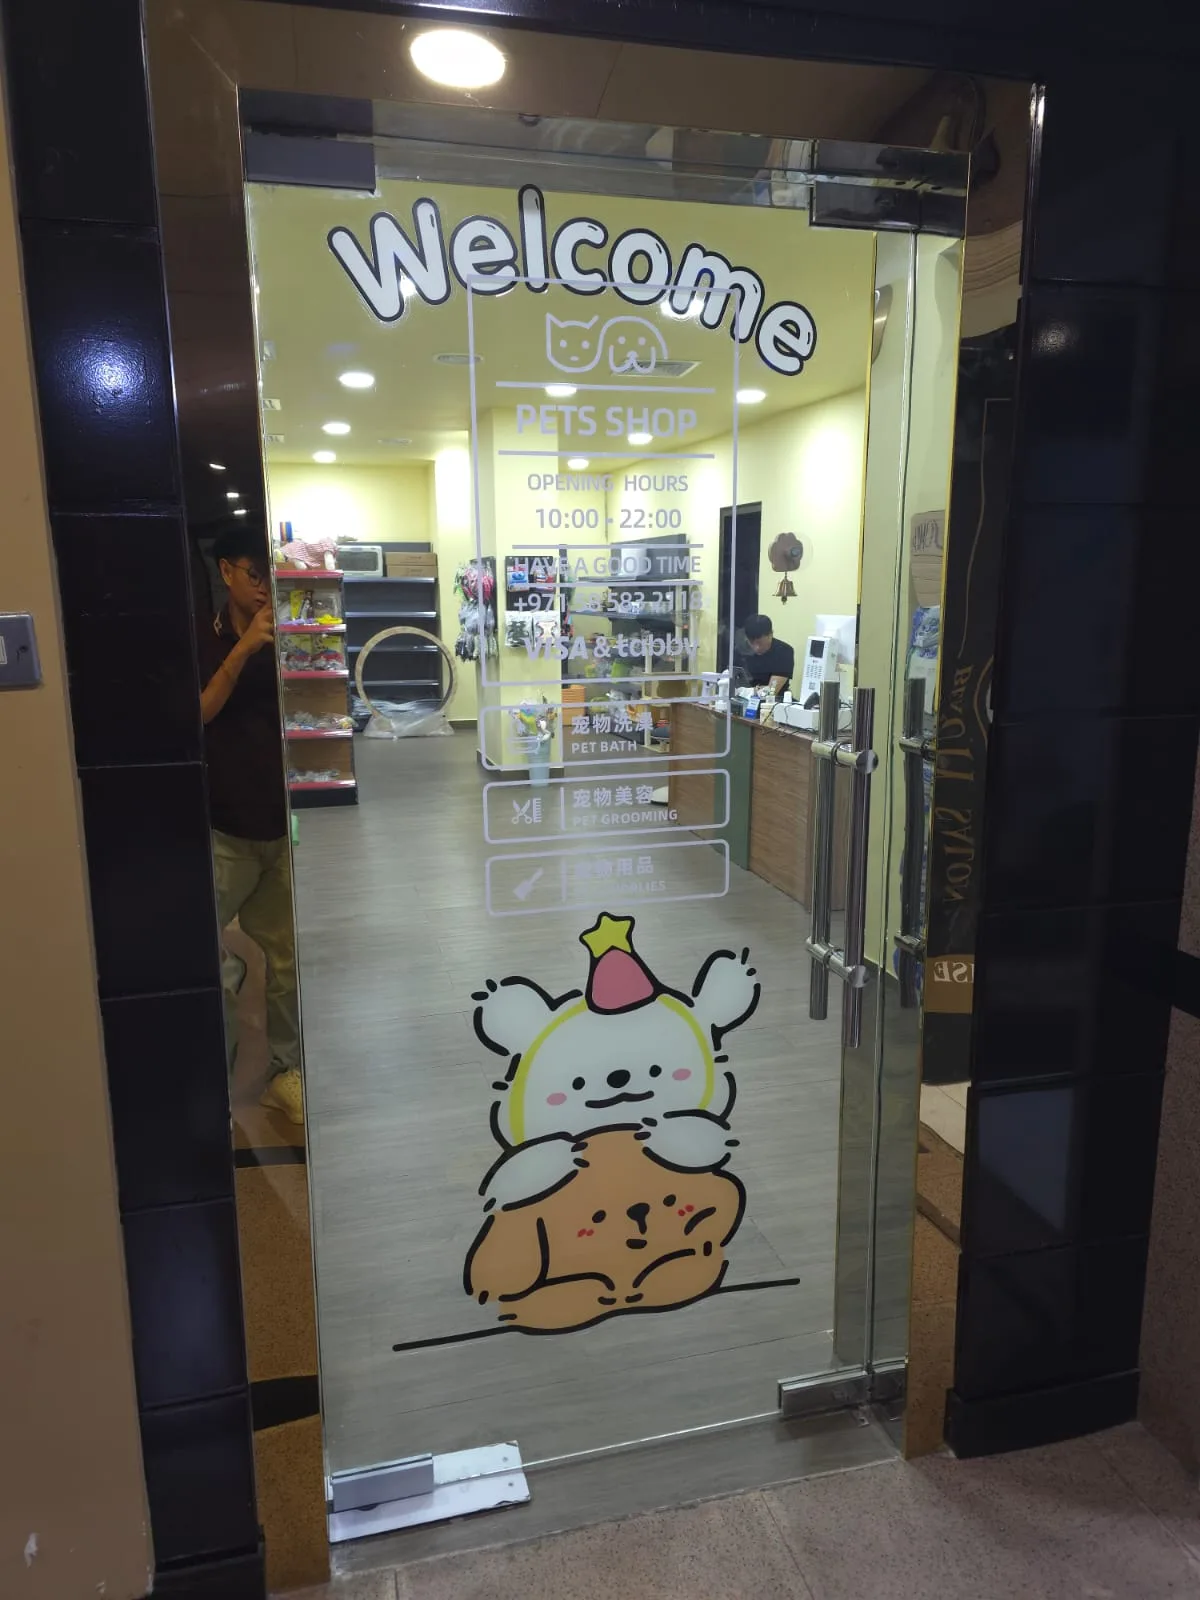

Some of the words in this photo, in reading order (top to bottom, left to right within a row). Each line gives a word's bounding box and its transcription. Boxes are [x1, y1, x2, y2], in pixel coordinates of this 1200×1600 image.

[327, 183, 817, 377] Welcome
[516, 404, 597, 436] PETS
[605, 405, 698, 438] SHOP
[527, 473, 614, 492] OPENING
[624, 474, 689, 492] HOURS
[535, 508, 598, 528] 10:00
[619, 508, 682, 528] 22:00
[513, 556, 570, 575] HAVE
[574, 556, 589, 575] A
[594, 556, 653, 575] GOOD
[655, 555, 702, 574] TIME
[513, 592, 567, 613] +971
[524, 635, 589, 661] VISA
[593, 636, 611, 658] &
[615, 632, 699, 661] tabby
[571, 742, 597, 754] PET
[600, 740, 638, 753] BATH
[572, 784, 655, 809] 宠物美容
[572, 814, 597, 827] PET
[600, 809, 679, 825] GROOMING
